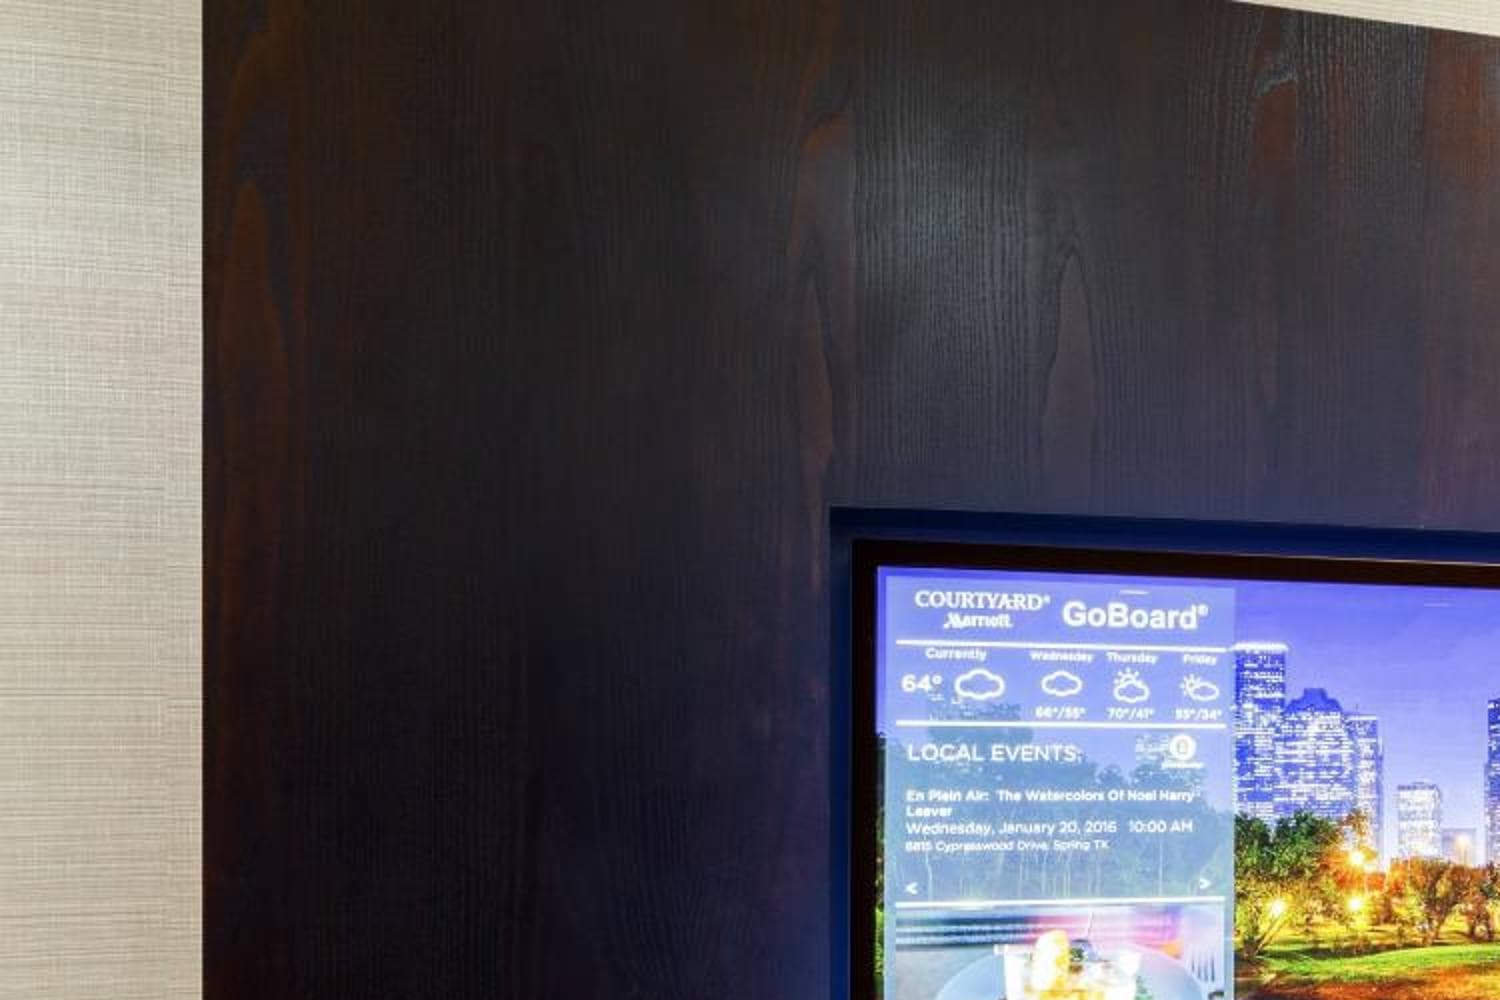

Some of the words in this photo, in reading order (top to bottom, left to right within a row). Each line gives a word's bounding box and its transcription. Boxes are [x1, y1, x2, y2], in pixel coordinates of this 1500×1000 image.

[943, 612, 1014, 629] Marriott
[925, 647, 987, 661] Currently
[1030, 651, 1094, 663] Wednesday
[1107, 652, 1158, 664] Thursday
[1183, 654, 1217, 665] Friday
[907, 744, 984, 762] LOCAL
[906, 789, 925, 801] En
[928, 789, 961, 801] Plain
[995, 789, 1021, 801] The
[1025, 789, 1104, 802] Watercolors
[1108, 789, 1124, 801] Of
[1127, 789, 1157, 801] Noel
[1160, 790, 1194, 803] Harry
[905, 822, 996, 836] Wednesday,
[998, 822, 1056, 836] January
[1085, 820, 1118, 833] 2016
[1170, 819, 1194, 833] AM
